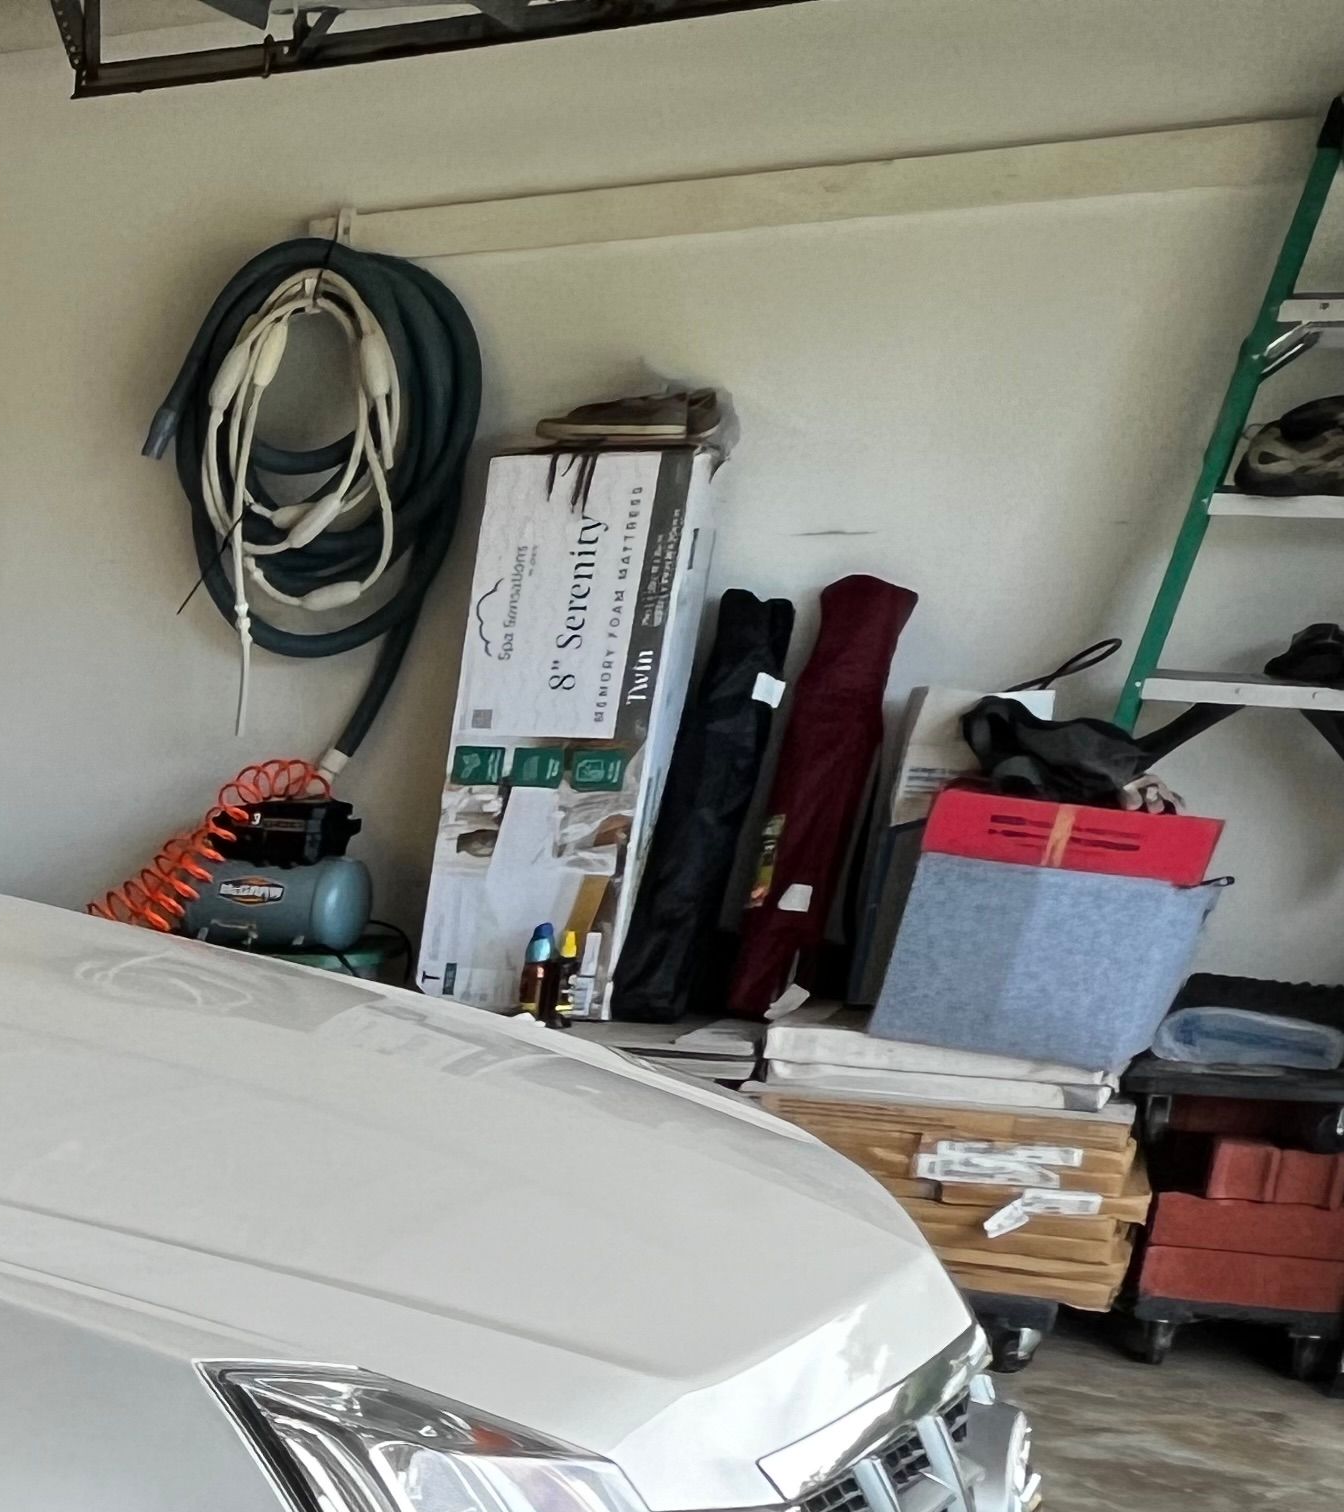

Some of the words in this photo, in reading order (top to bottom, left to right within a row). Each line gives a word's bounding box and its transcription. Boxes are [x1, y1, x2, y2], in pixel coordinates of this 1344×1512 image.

[555, 515, 609, 650] Serenity
[498, 632, 515, 661] Spa
[625, 649, 654, 706] Twin
